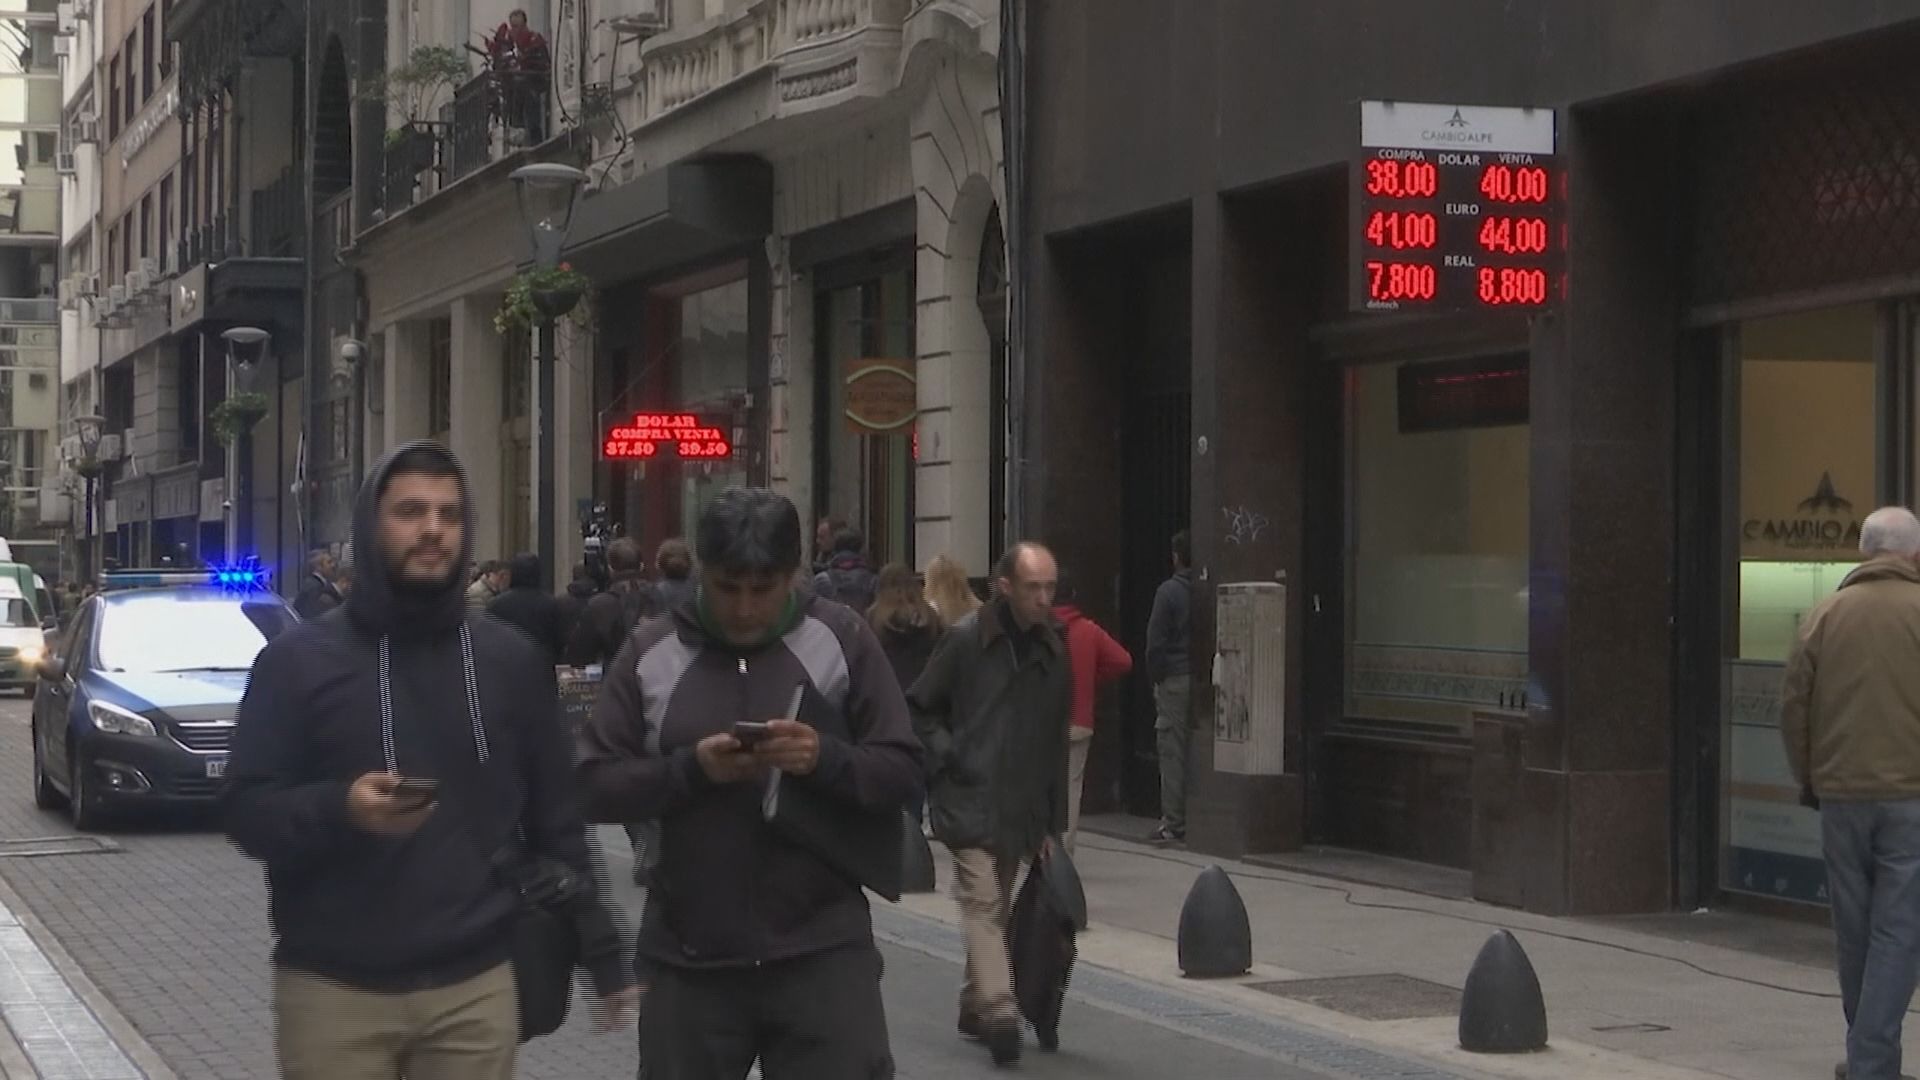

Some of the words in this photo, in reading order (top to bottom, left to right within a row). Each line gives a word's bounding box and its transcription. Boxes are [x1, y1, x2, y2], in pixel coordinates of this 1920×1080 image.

[1378, 149, 1425, 161] COMPRA
[1438, 153, 1480, 166] DOLAR
[1499, 153, 1533, 165] VENTA
[1367, 160, 1436, 198] 38,00
[1481, 165, 1547, 203] 40,00
[1446, 203, 1479, 216] EURO
[1367, 211, 1436, 249] 41,00
[1479, 216, 1547, 254] 44,00
[1444, 255, 1475, 267] REAL
[1367, 263, 1435, 300] 7,800
[1479, 267, 1546, 304] 8,800
[637, 415, 695, 428] DOLAR
[612, 429, 671, 440] COMPRA
[674, 429, 720, 440] VENTA
[679, 441, 728, 455] 39.50
[1743, 519, 1860, 541] CAMBIOA
